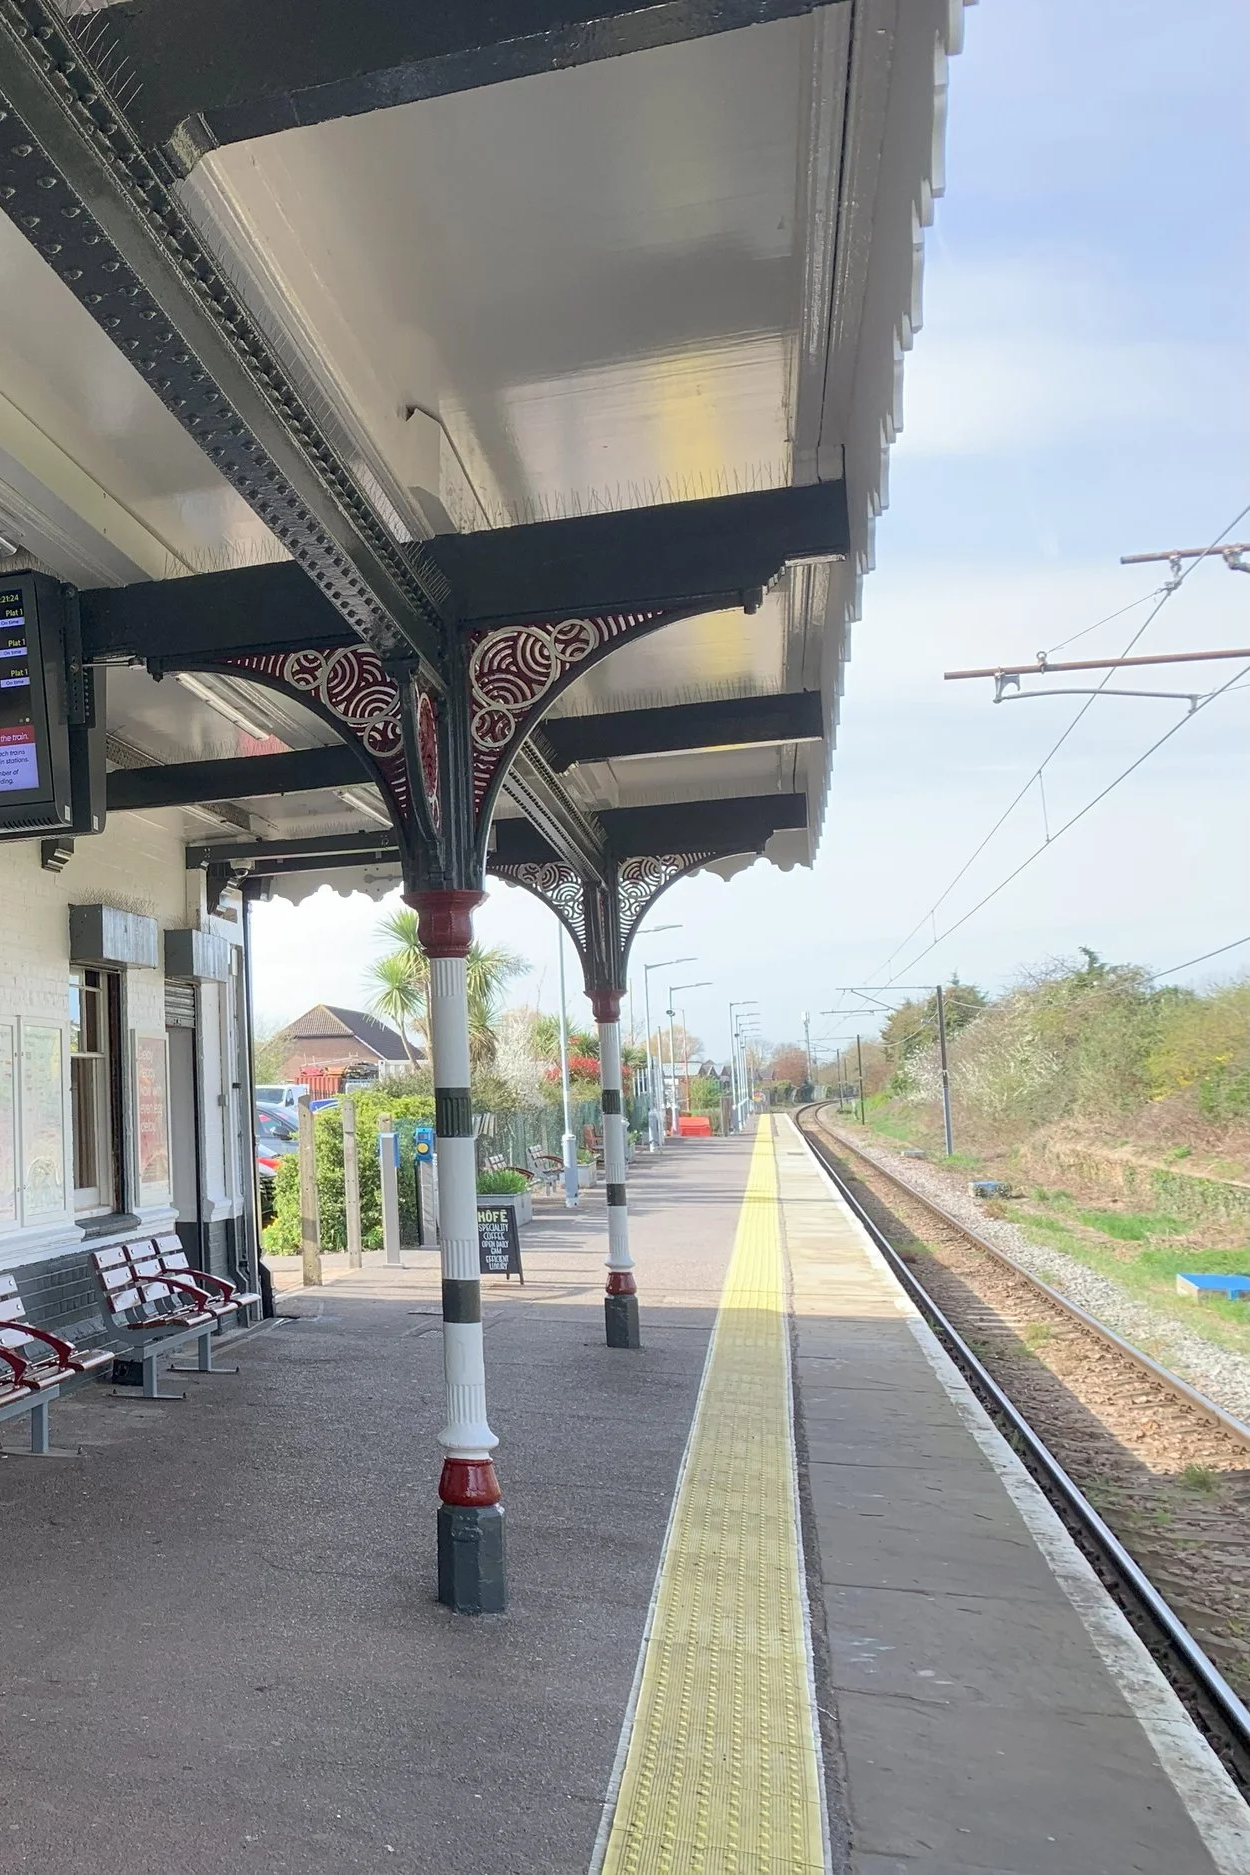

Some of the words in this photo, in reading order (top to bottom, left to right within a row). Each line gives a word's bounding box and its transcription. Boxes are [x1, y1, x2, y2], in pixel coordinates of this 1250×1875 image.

[6, 609, 20, 617] Plat
[11, 669, 24, 677] Plat
[12, 733, 29, 741] train.
[478, 1224, 508, 1232] SPECIALITY
[483, 1232, 505, 1240] COFFEE
